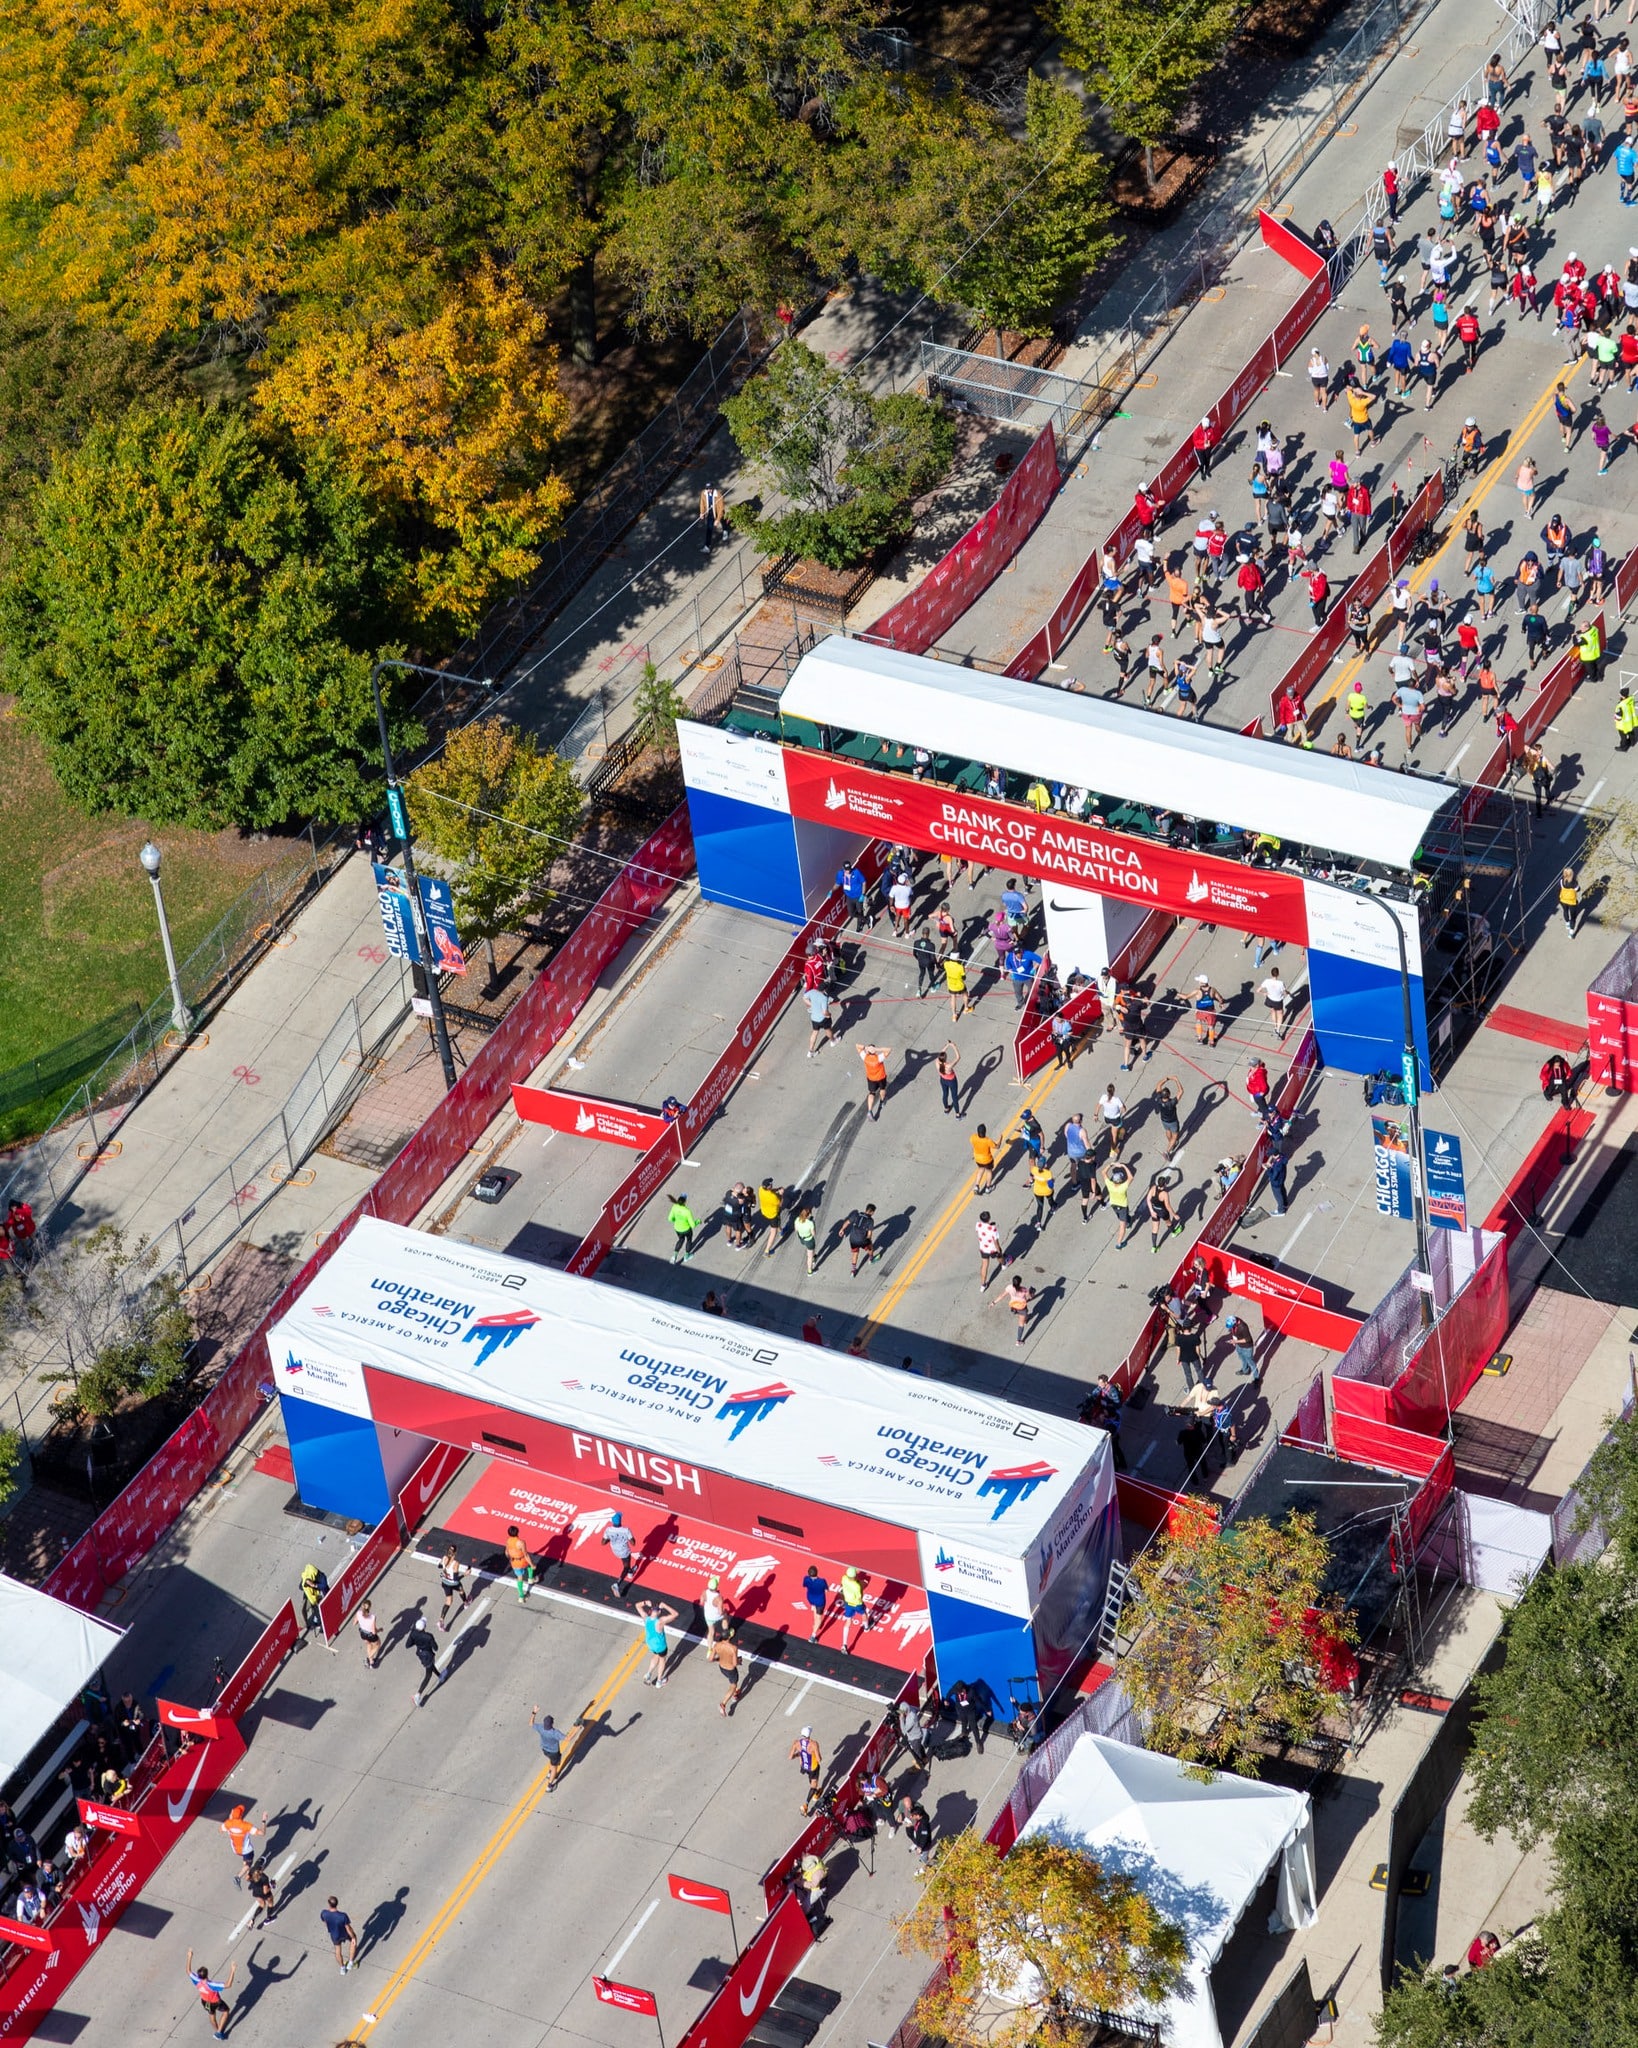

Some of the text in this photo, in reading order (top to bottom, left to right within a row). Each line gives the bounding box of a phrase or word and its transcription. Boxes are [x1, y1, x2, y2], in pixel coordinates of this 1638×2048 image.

[848, 794, 883, 811] Chicago
[849, 802, 893, 822] Marathon
[942, 804, 1142, 870] BANK OF AMERICA
[929, 822, 1158, 895] CHICAGO MARATHON
[1211, 887, 1248, 904] Chicago
[1212, 896, 1258, 914] Marathon
[378, 892, 402, 957] CHICAGO
[400, 934, 408, 951] YOUR
[402, 952, 410, 960] IS
[753, 960, 796, 1028] ENDURANCE
[1025, 1040, 1046, 1062] BANK
[700, 1064, 728, 1108] Advocate
[700, 1068, 736, 1122] Health Care
[597, 1118, 628, 1132] Chicago
[598, 1124, 637, 1142] Marathon
[638, 1148, 672, 1188] CONSULTANCY
[640, 1169, 661, 1195] SERVICES
[1375, 1145, 1392, 1215] CHICAGO
[1390, 1167, 1398, 1189] START
[1391, 1189, 1399, 1208] YOUR
[1393, 1209, 1400, 1218] IS
[404, 1246, 503, 1278] WORLD MARATHON MAJORS
[472, 1274, 500, 1283] ABBOTT
[370, 1278, 476, 1320] Marathon
[340, 1310, 449, 1348] BANK OF AMERICA
[378, 1300, 462, 1336] Chicago
[650, 1316, 754, 1352] WORLD MARATHON MAJORS
[721, 1344, 750, 1358] ABBOTT
[306, 1362, 338, 1378] Chicago
[306, 1370, 348, 1388] Marathon
[619, 1349, 728, 1394] Marathon
[590, 1384, 701, 1424] BANK OF AMERICA
[628, 1374, 714, 1410] Chicago
[908, 1392, 1014, 1426] WORLD MARATHON MAJORS
[980, 1420, 1011, 1432] ABBOTT
[877, 1425, 988, 1469] Marathon
[572, 1432, 702, 1496] FINISH
[848, 1460, 962, 1500] BANK OF AMERICA
[886, 1448, 975, 1486] Chicago
[491, 1510, 526, 1524] AMERICA
[509, 1488, 578, 1514] Marathon
[514, 1502, 569, 1525] Chicago
[538, 1523, 560, 1534] BANK
[1054, 1503, 1084, 1547] Chicago
[1056, 1506, 1094, 1560] Marathon
[667, 1533, 738, 1562] Marathon
[672, 1548, 728, 1572] Chicago
[958, 1560, 993, 1576] Chicago
[958, 1568, 1002, 1586] Marathon
[242, 1677, 252, 1691] OF
[252, 1638, 280, 1680] AMERICA
[92, 1853, 128, 1898] BANK OF AMERICA
[96, 1870, 125, 1908] Chicago
[102, 1872, 137, 1918] Marathon
[2, 1972, 48, 2032] OF AMERICA
